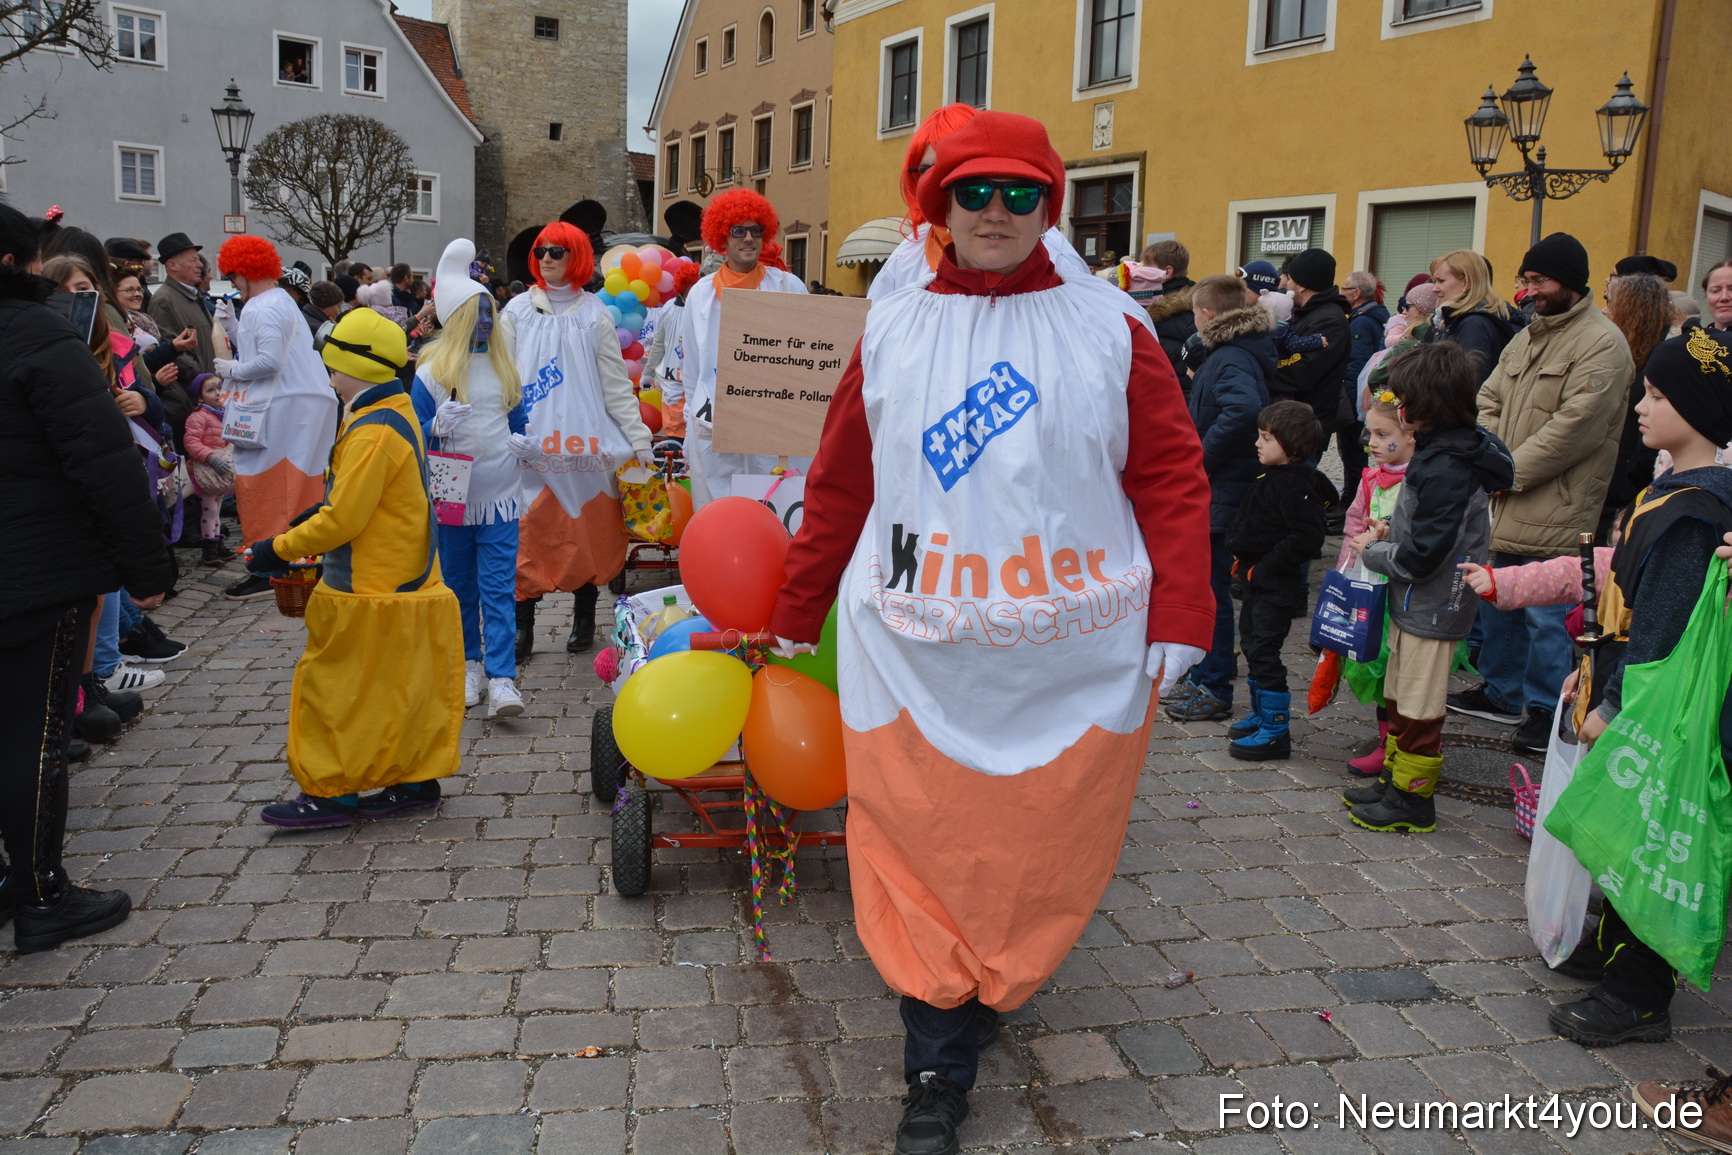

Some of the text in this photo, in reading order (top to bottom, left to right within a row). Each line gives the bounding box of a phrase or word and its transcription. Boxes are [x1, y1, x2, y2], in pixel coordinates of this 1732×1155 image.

[1263, 219, 1307, 239] BW
[1261, 241, 1307, 252] Bekleidung
[1252, 273, 1276, 284] uvex
[742, 333, 834, 351] Immer für eine
[733, 348, 841, 371] Überraschung gut!
[726, 384, 835, 402] Boierstraße Pollan
[522, 454, 615, 474] SCHUNG
[885, 523, 1113, 600] Kinder
[1609, 716, 1663, 757] Hier
